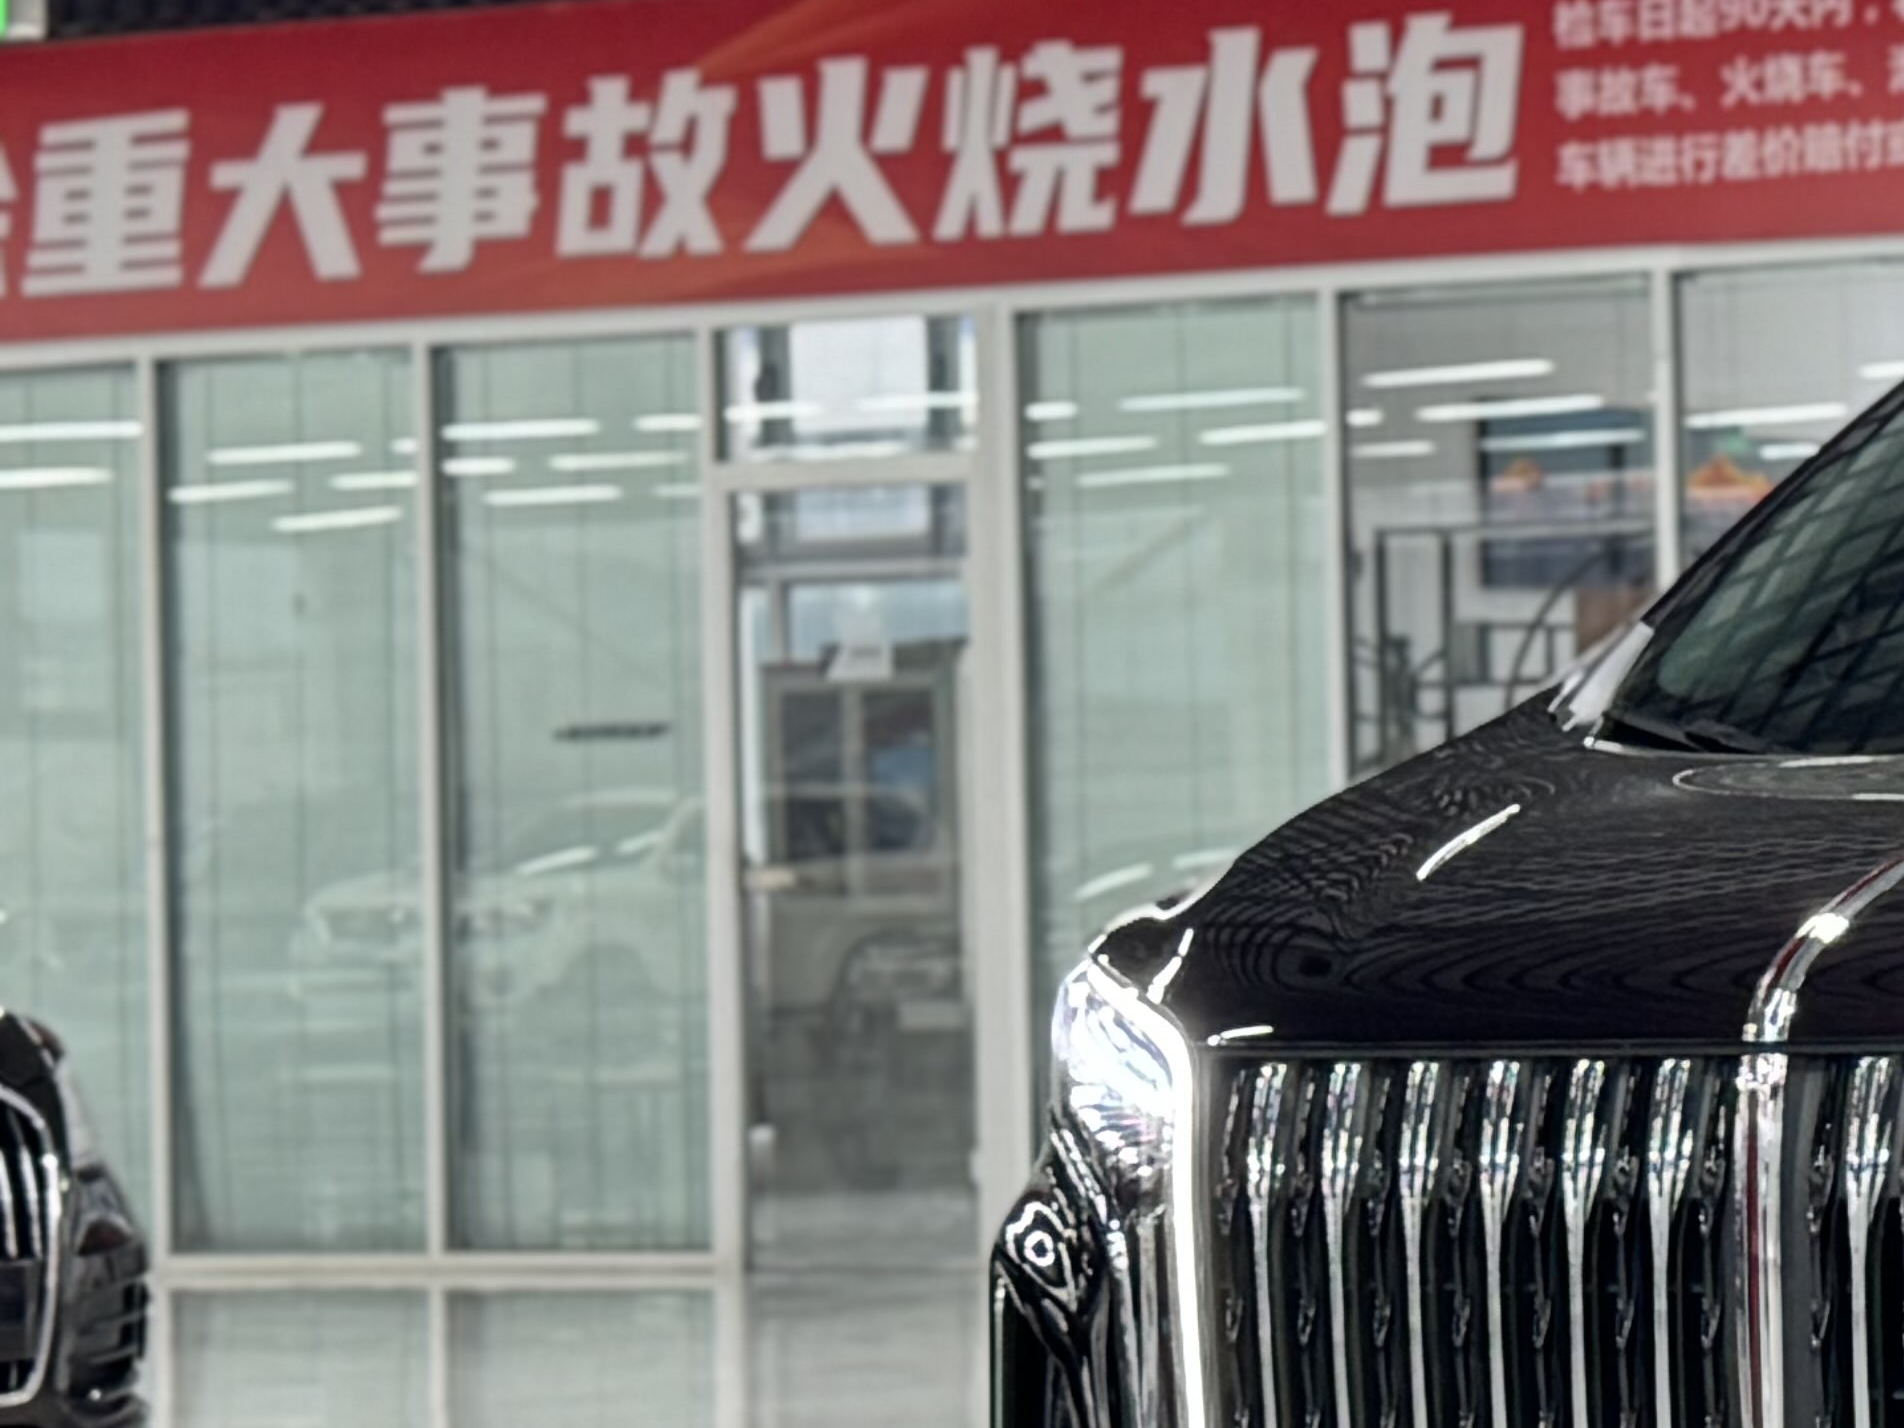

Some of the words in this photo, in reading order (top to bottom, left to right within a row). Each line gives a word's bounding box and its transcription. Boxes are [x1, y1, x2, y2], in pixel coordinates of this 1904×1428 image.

[0, 12, 1525, 299] 重大事故火烧水泡
